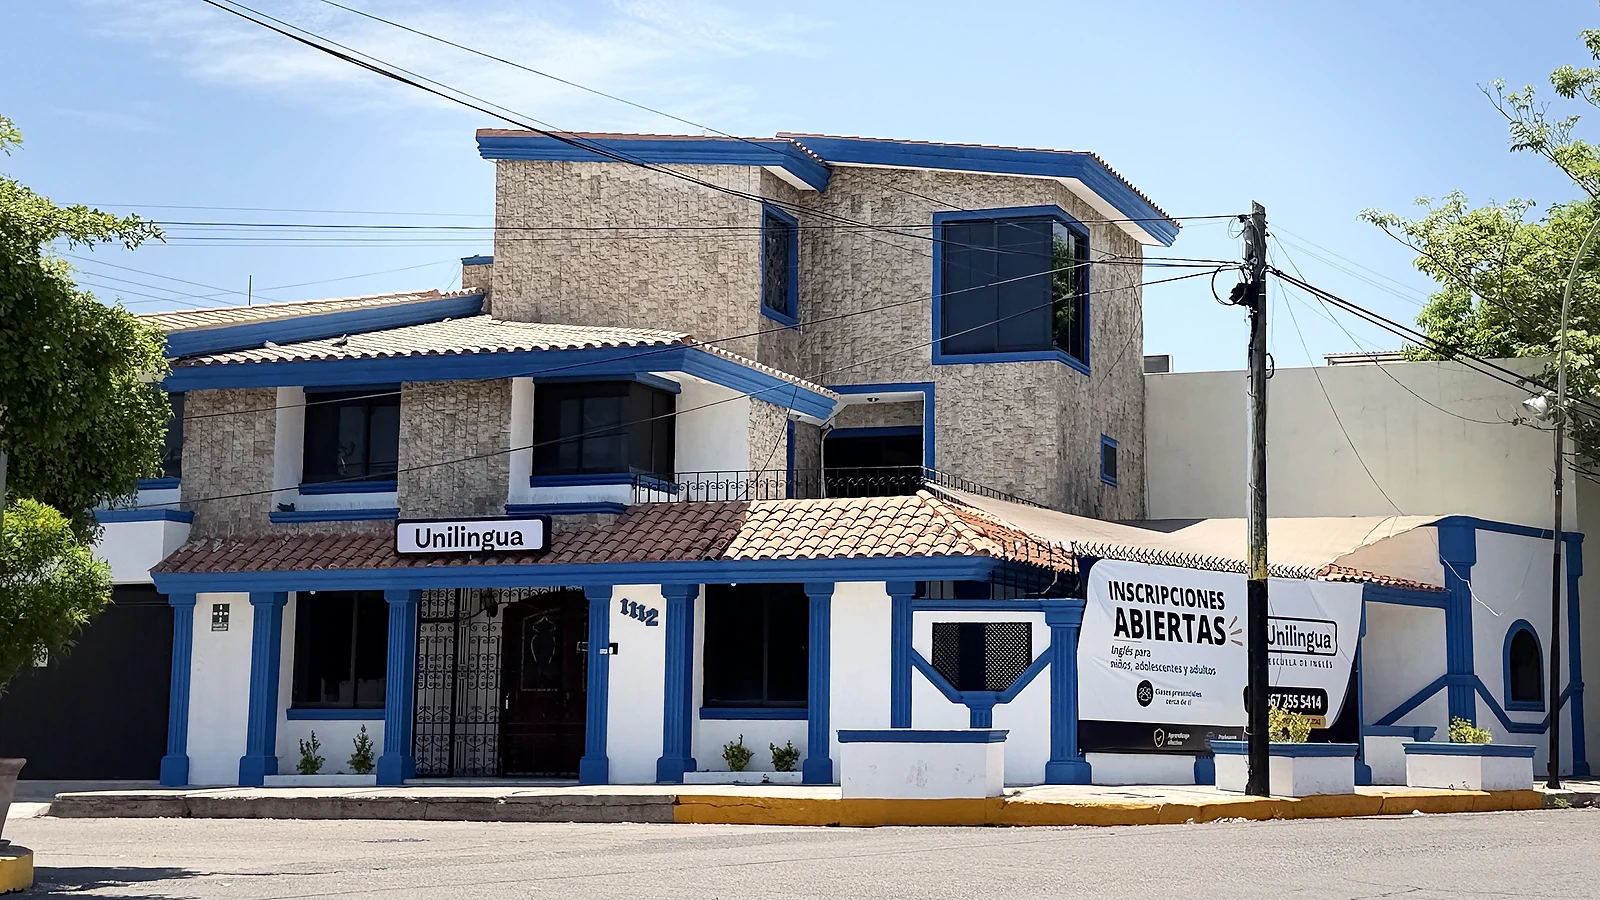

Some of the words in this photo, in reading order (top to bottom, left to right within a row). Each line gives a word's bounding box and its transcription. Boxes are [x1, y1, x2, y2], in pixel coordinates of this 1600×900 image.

[415, 525, 523, 551] Unilingua
[1108, 580, 1225, 610] INSCRIPCIONES
[619, 597, 659, 627] 1112
[1114, 607, 1226, 646] ABIERTAS
[1111, 645, 1133, 657] Inglés
[1134, 648, 1152, 659] para
[1110, 659, 1133, 672] niños,
[1135, 661, 1182, 674] adolescentes
[1183, 666, 1188, 677] y
[1189, 664, 1217, 676] adultos
[1282, 694, 1299, 709] 255
[1300, 695, 1322, 709] 5414
